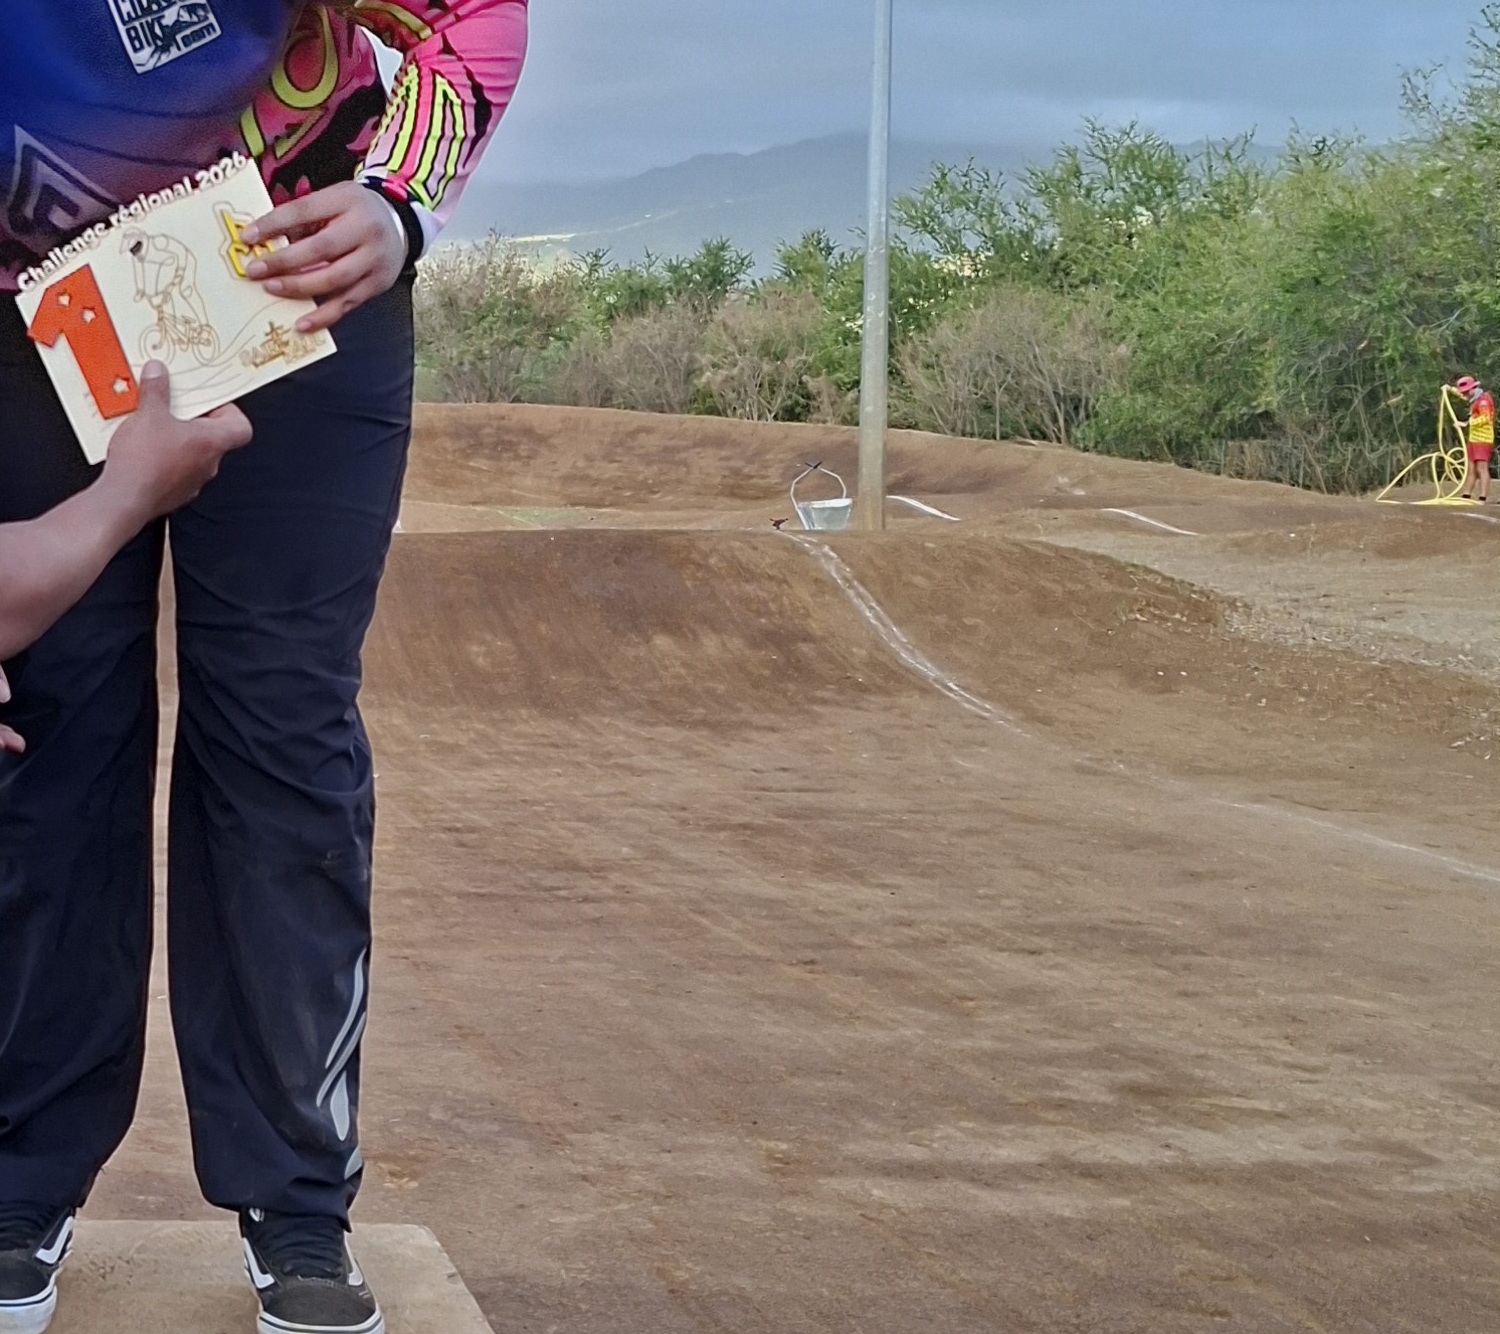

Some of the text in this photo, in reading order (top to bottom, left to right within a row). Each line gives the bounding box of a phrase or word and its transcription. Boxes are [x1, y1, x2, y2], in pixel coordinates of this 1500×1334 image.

[16, 150, 249, 293] Challenge régional 2026
[27, 263, 139, 420] 1
